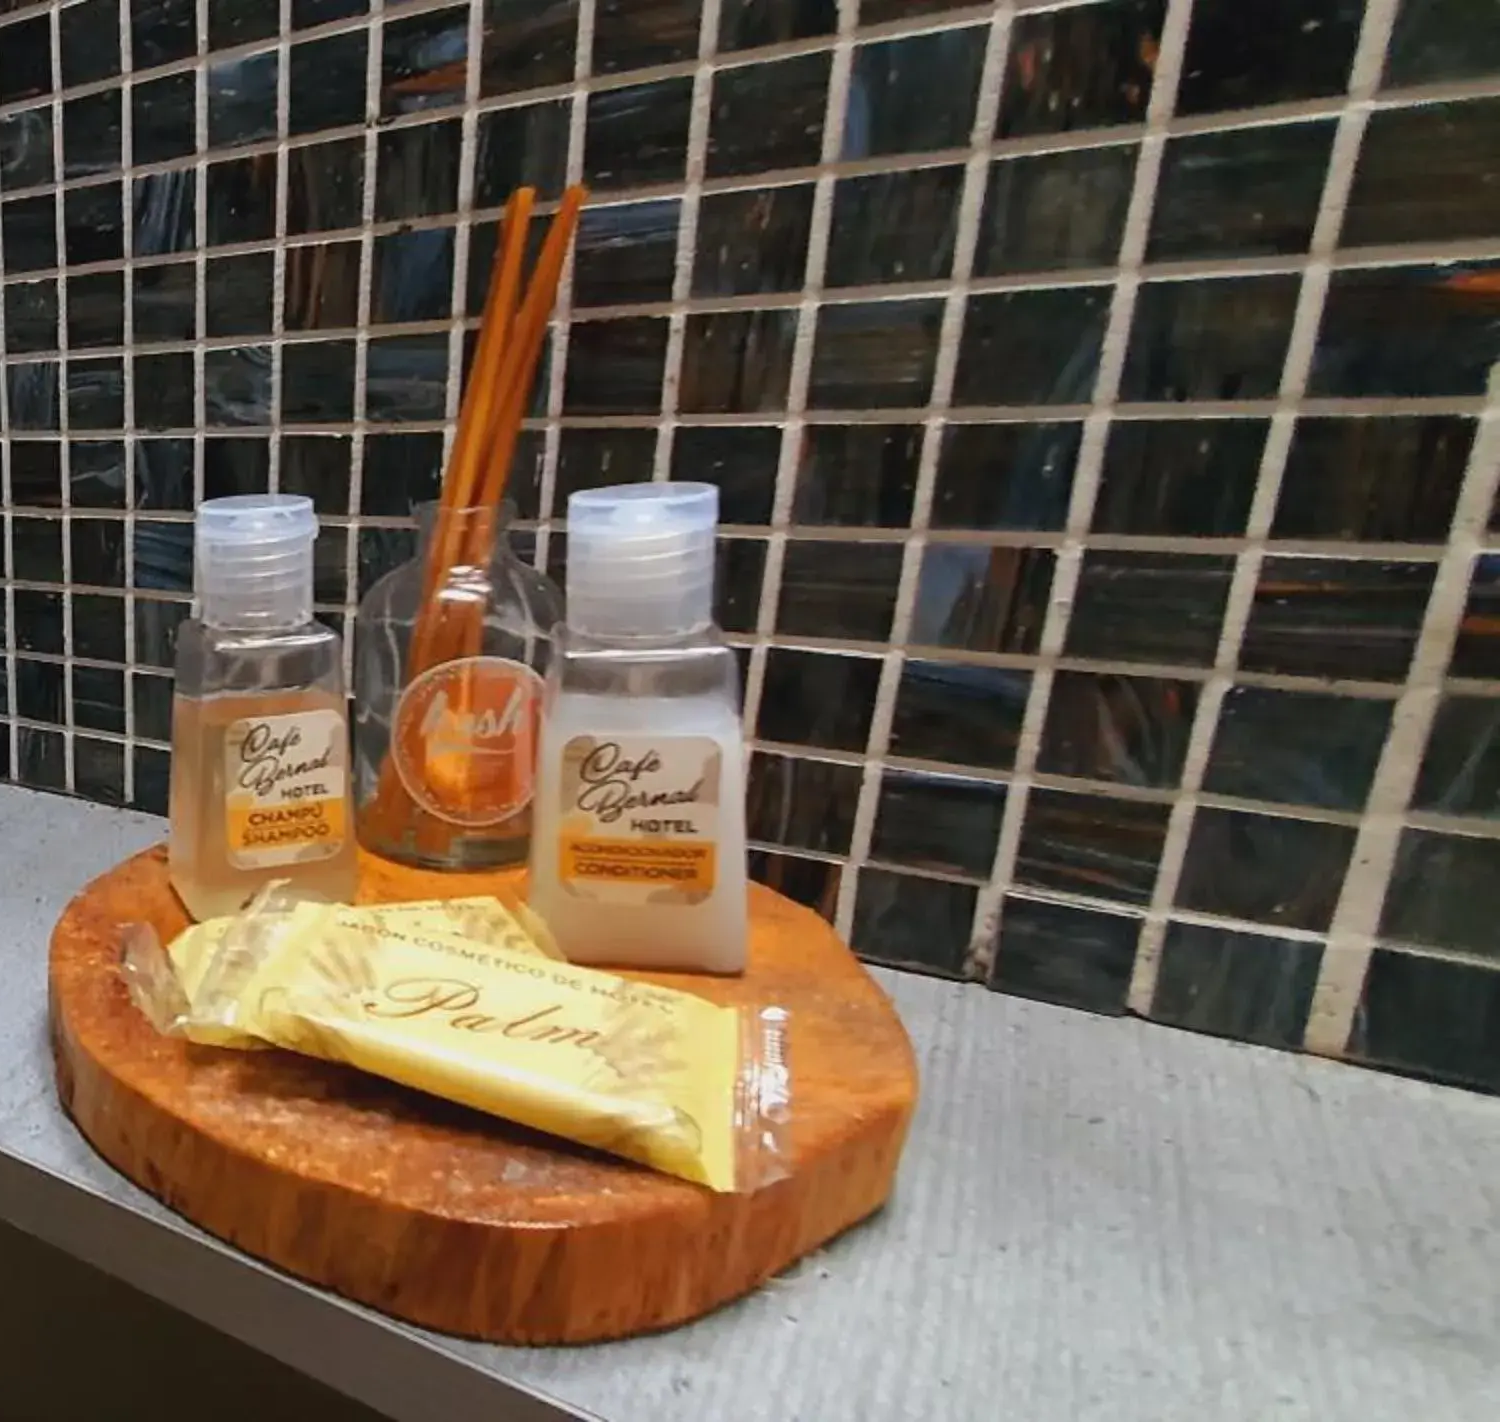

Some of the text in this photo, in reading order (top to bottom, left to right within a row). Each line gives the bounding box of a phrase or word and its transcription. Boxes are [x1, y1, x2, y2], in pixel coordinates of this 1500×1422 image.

[241, 723, 302, 763] Café
[239, 747, 331, 797] Bernal
[579, 742, 661, 784] Café
[280, 783, 329, 799] HOTEL
[577, 777, 705, 823] Bernal
[242, 822, 331, 847] SHAMPOO
[630, 818, 699, 833] HOTEL
[574, 863, 698, 879] CONDITIONER
[553, 974, 583, 991] DE
[363, 978, 601, 1049] Palm
